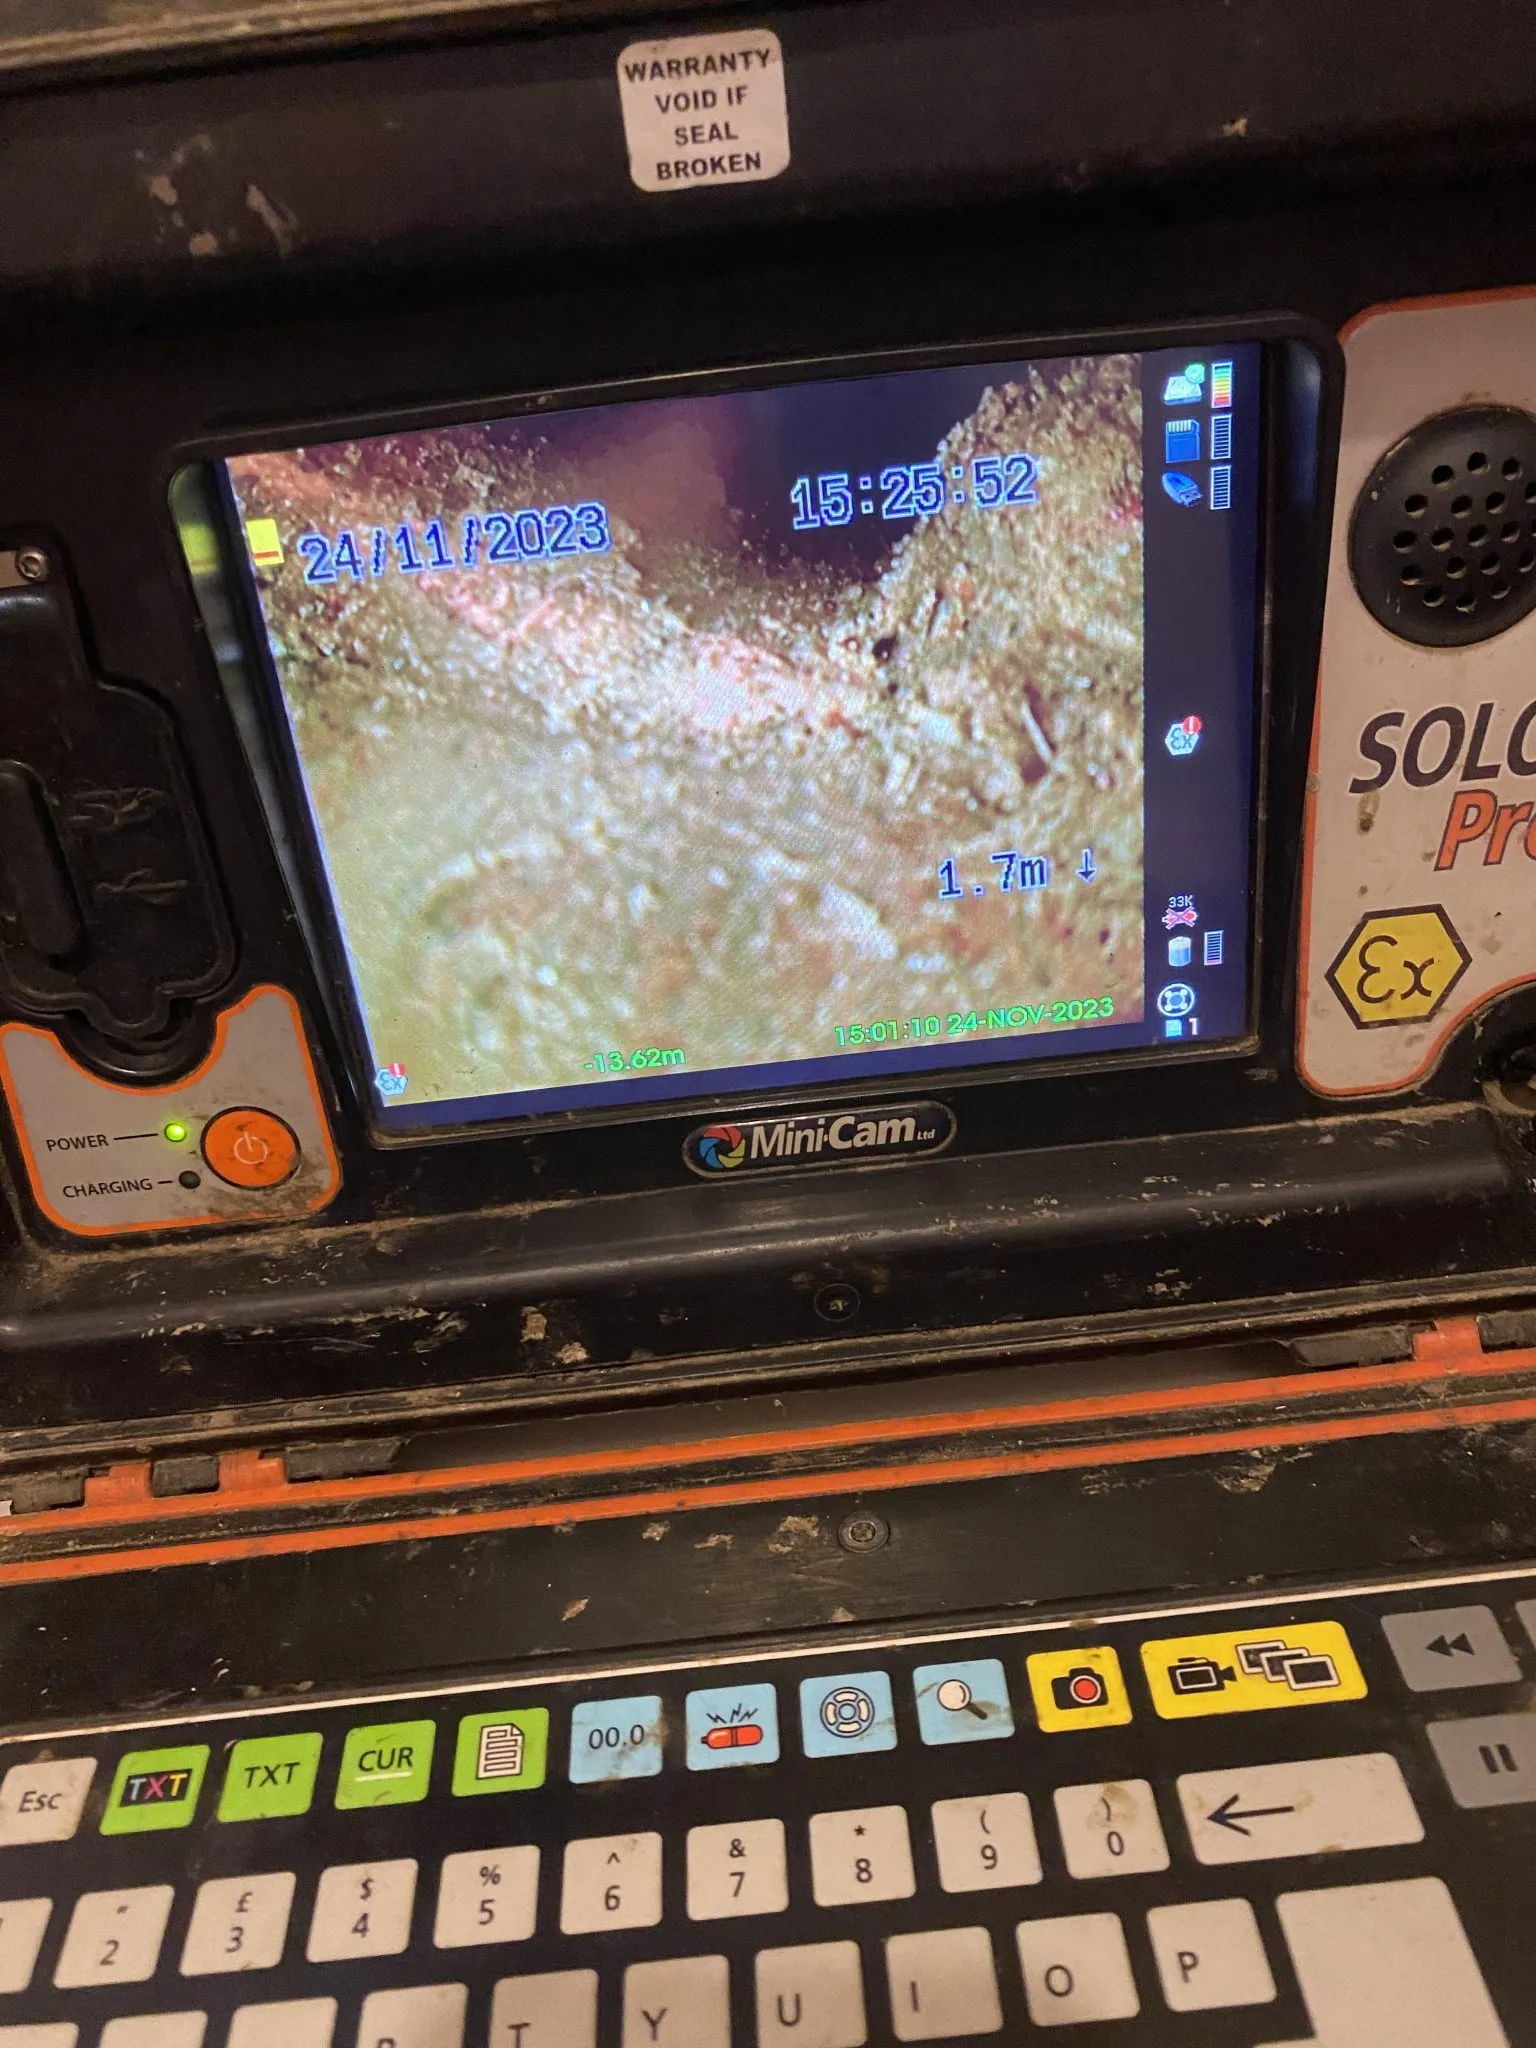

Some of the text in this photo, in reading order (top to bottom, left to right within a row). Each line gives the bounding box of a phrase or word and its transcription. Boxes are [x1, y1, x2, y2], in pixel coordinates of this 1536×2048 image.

[624, 48, 771, 83] WARRANTY
[656, 86, 747, 113] VOID IF
[675, 122, 738, 146] SEAL
[656, 152, 762, 181] BROKEN
[789, 451, 1038, 530] 15:25:52
[299, 500, 612, 585] 24/11/2023
[1432, 788, 1536, 872] Pr
[938, 849, 1050, 900] 1.7m
[1168, 895, 1193, 908] 33K
[834, 995, 1114, 1046] 15:01:10 24-NOV-2023
[584, 1047, 686, 1073] -13.62m
[46, 1135, 109, 1151] POWER
[917, 1128, 936, 1142] Ltd
[63, 1179, 152, 1197] CHARGING
[589, 1725, 645, 1749] 00.0
[358, 1747, 413, 1771] CUR
[127, 1772, 188, 1801] TXT
[245, 1762, 300, 1788] TXT
[18, 1791, 62, 1812] Esc
[729, 1839, 745, 1858] &
[981, 1845, 997, 1870] 9
[480, 1865, 500, 1885] %
[856, 1858, 872, 1883] 8
[361, 1878, 373, 1900] $
[730, 1872, 745, 1897] 7
[236, 1892, 252, 1913] £
[605, 1885, 620, 1910] 6
[480, 1899, 494, 1925] 5
[352, 1913, 368, 1937] 4
[100, 1940, 119, 1965] 2
[226, 1927, 243, 1953] 3
[1178, 1951, 1198, 1982] P
[1045, 1965, 1073, 1998] O
[778, 1994, 801, 2027] U
[508, 2023, 530, 2048] T
[642, 2008, 667, 2040] Y
